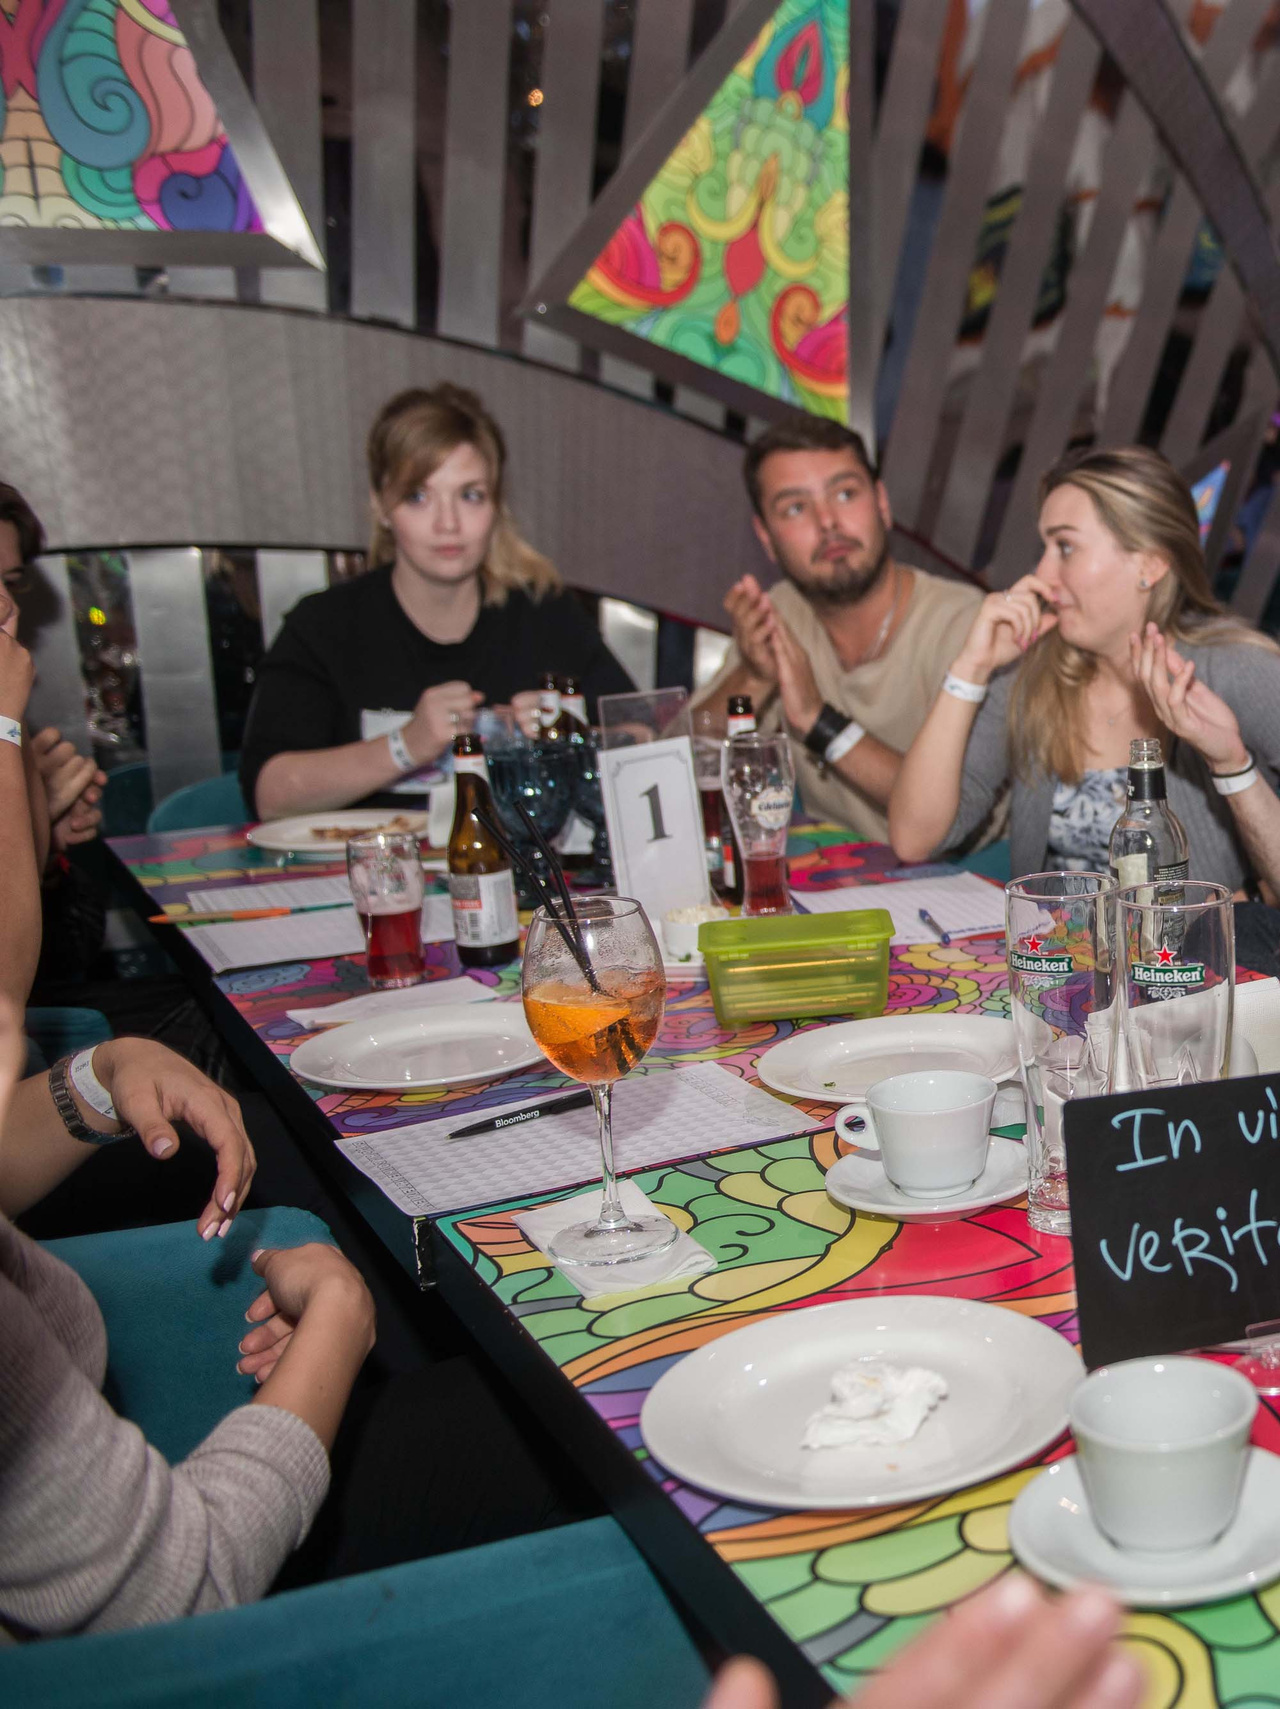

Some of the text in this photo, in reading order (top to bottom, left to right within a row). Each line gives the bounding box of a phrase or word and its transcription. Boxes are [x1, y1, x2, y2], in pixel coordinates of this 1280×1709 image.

[639, 783, 673, 843] 1
[1011, 953, 1069, 972] Heineken
[1134, 968, 1201, 983] Heineken
[495, 1110, 540, 1128] Bloomberg
[1111, 1107, 1201, 1172] In
